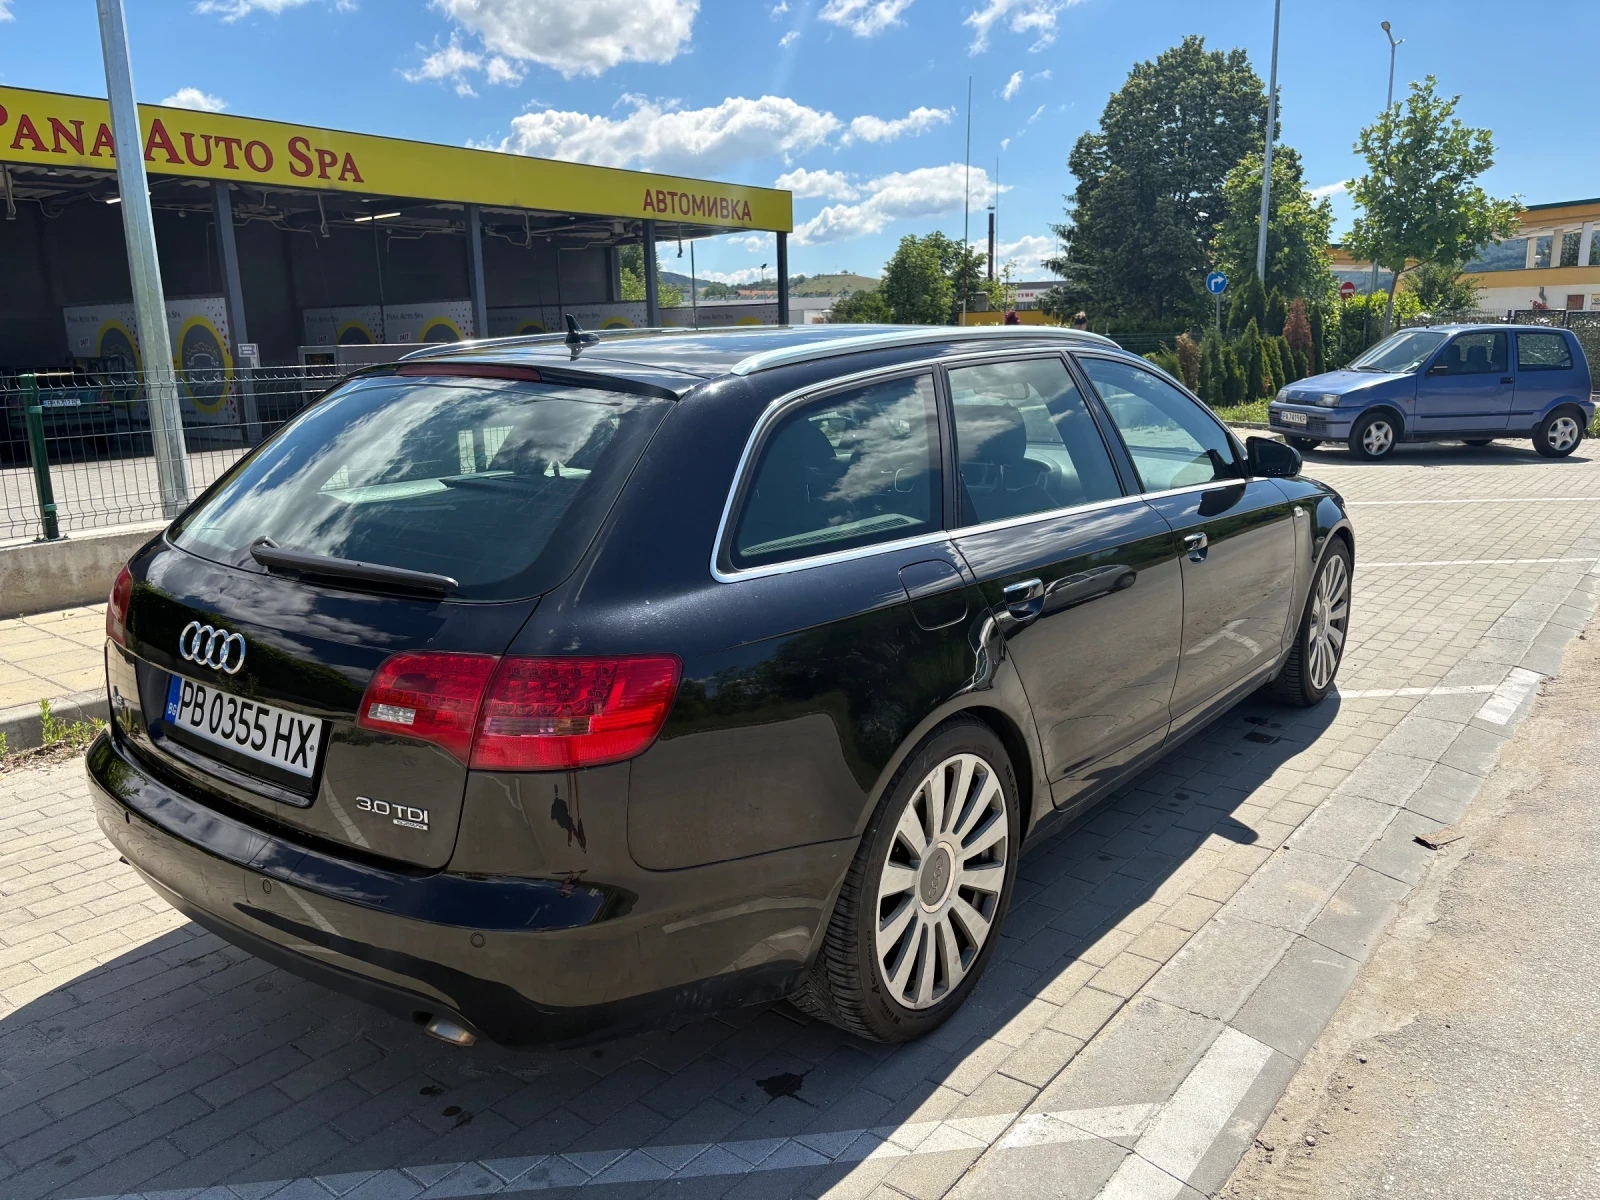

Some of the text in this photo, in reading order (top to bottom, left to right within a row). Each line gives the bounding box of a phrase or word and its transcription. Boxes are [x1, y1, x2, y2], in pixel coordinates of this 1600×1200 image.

[144, 118, 274, 173] AUTO
[287, 136, 365, 183] SPA
[642, 188, 753, 222] АВТОМИВКА
[167, 702, 178, 716] BG
[178, 679, 314, 769] PB 0355 HX
[355, 796, 429, 824] 3.0 TDI
